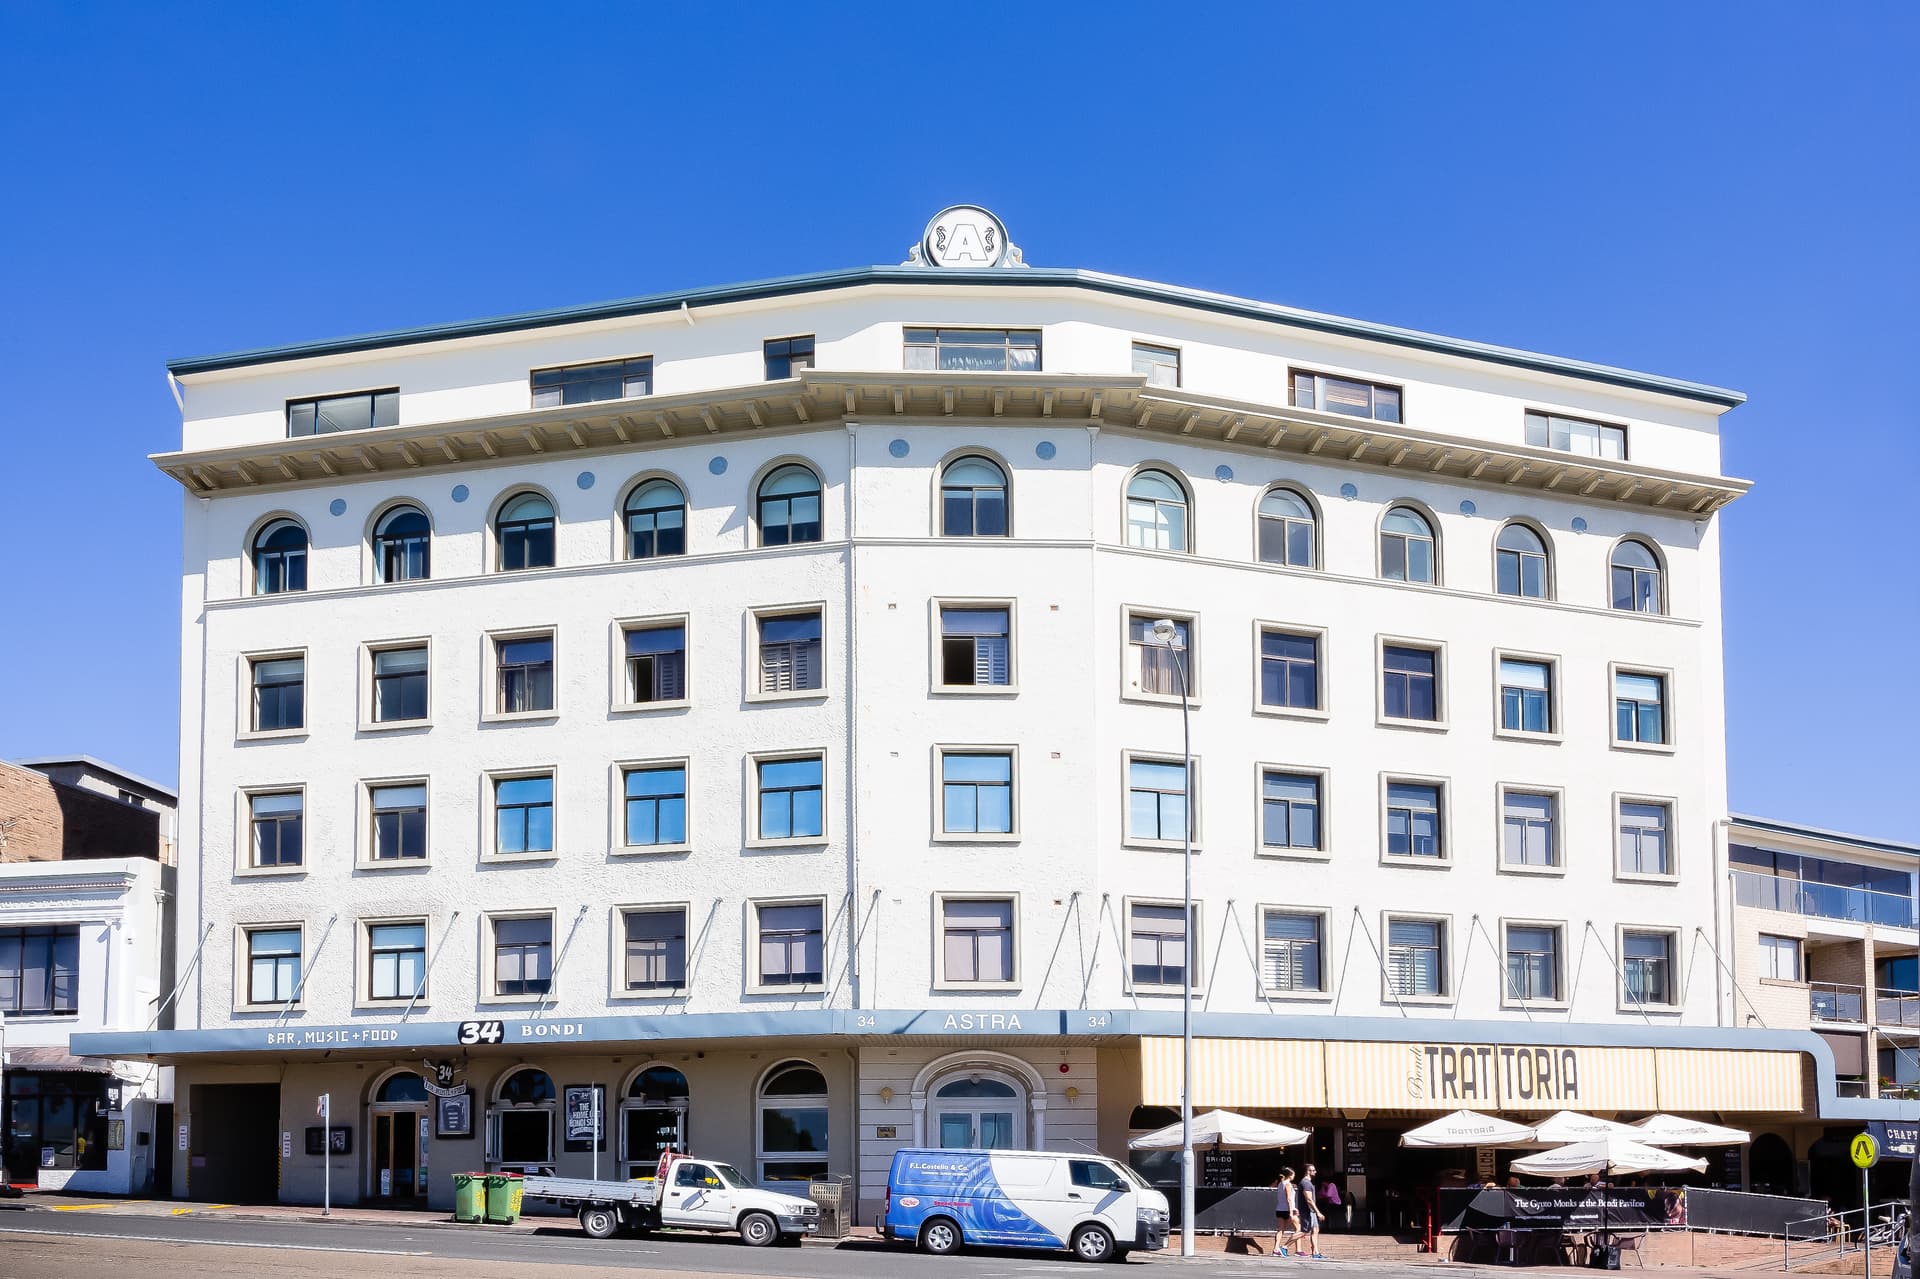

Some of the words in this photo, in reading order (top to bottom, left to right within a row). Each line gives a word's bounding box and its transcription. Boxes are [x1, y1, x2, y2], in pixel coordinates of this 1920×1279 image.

[942, 224, 989, 261] A
[857, 1016, 875, 1027] 34
[944, 1014, 1022, 1030] ASTRA
[1088, 1016, 1106, 1027] 34
[460, 1021, 501, 1044] 34
[521, 1023, 584, 1037] BONDI
[438, 1065, 453, 1080] 34
[1406, 1046, 1424, 1099] Bondi
[1425, 1046, 1579, 1100] TRATTORIA
[579, 1102, 590, 1111] THE
[1514, 1199, 1529, 1208] The
[1553, 1199, 1577, 1208] Monks
[1585, 1198, 1597, 1207] the
